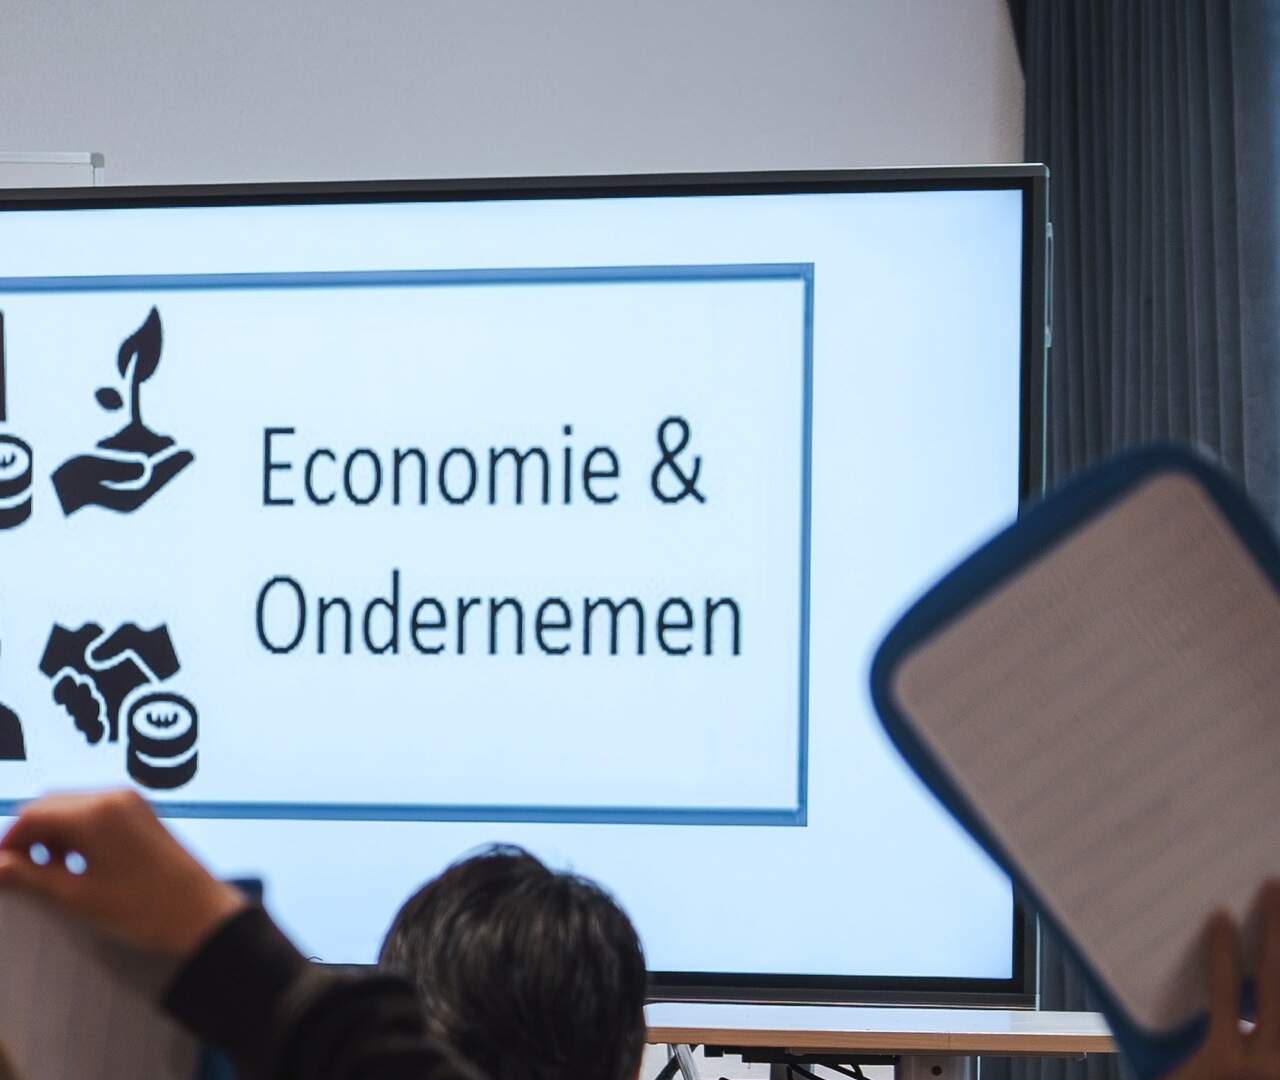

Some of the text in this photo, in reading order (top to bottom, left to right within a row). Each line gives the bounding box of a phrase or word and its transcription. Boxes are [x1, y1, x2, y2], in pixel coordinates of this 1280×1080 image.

[263, 415, 706, 507] Economie &
[255, 569, 742, 658] Ondernemen
